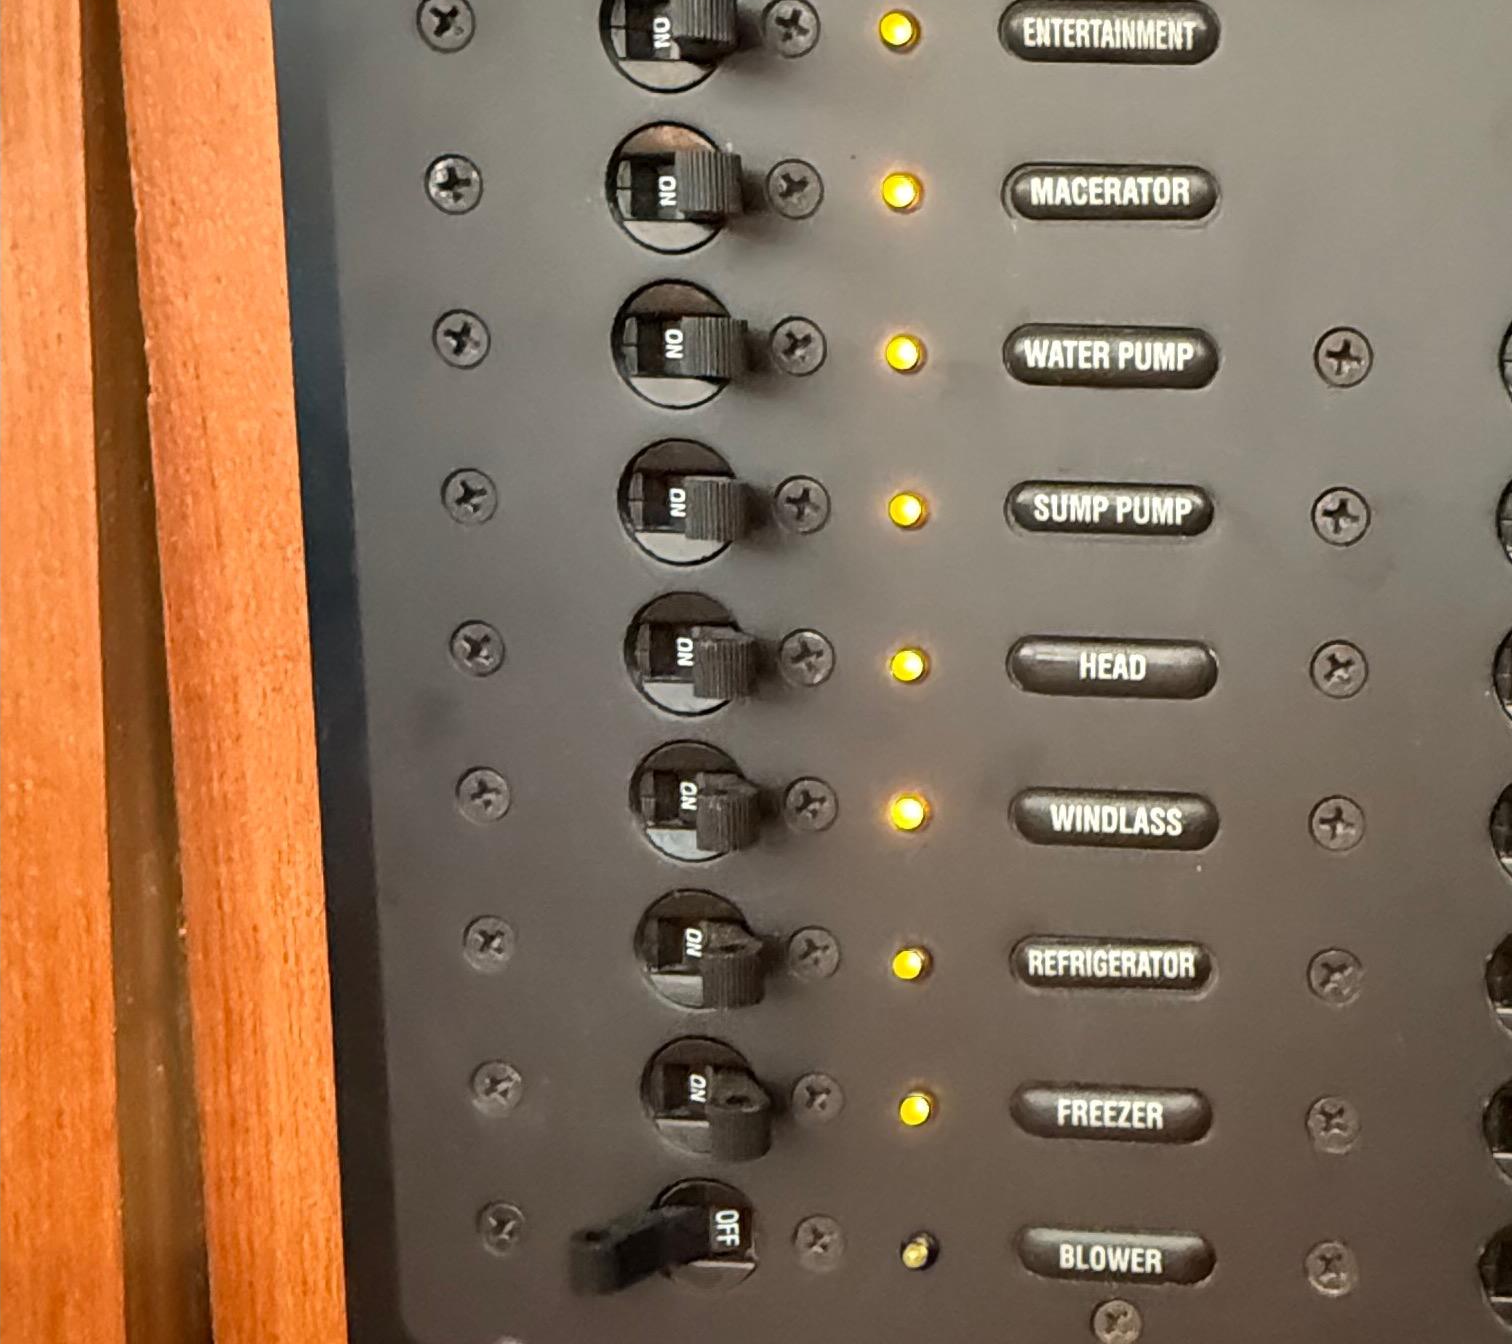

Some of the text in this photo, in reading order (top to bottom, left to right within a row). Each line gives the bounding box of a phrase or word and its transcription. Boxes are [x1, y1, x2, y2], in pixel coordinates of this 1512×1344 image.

[653, 16, 672, 49] ON
[1022, 16, 1201, 50] ENTERTAINMENT
[658, 175, 677, 207] ON
[1029, 176, 1191, 206] MACERATOR
[664, 328, 684, 359] ON
[1024, 339, 1195, 372] WATER PUMP
[669, 487, 687, 518] ON
[1033, 494, 1192, 525] SUMP PUMP
[676, 637, 694, 667] ON
[1078, 653, 1147, 681] HEAD
[679, 781, 698, 811] ON
[1049, 804, 1183, 835] WINDLASS
[685, 928, 703, 958] ON
[1027, 947, 1197, 978] REFRIGERATOR
[689, 1074, 707, 1103] ON
[1056, 1099, 1164, 1130] FREEZER
[715, 1210, 740, 1246] OFF
[1059, 1243, 1162, 1273] BLOWER
